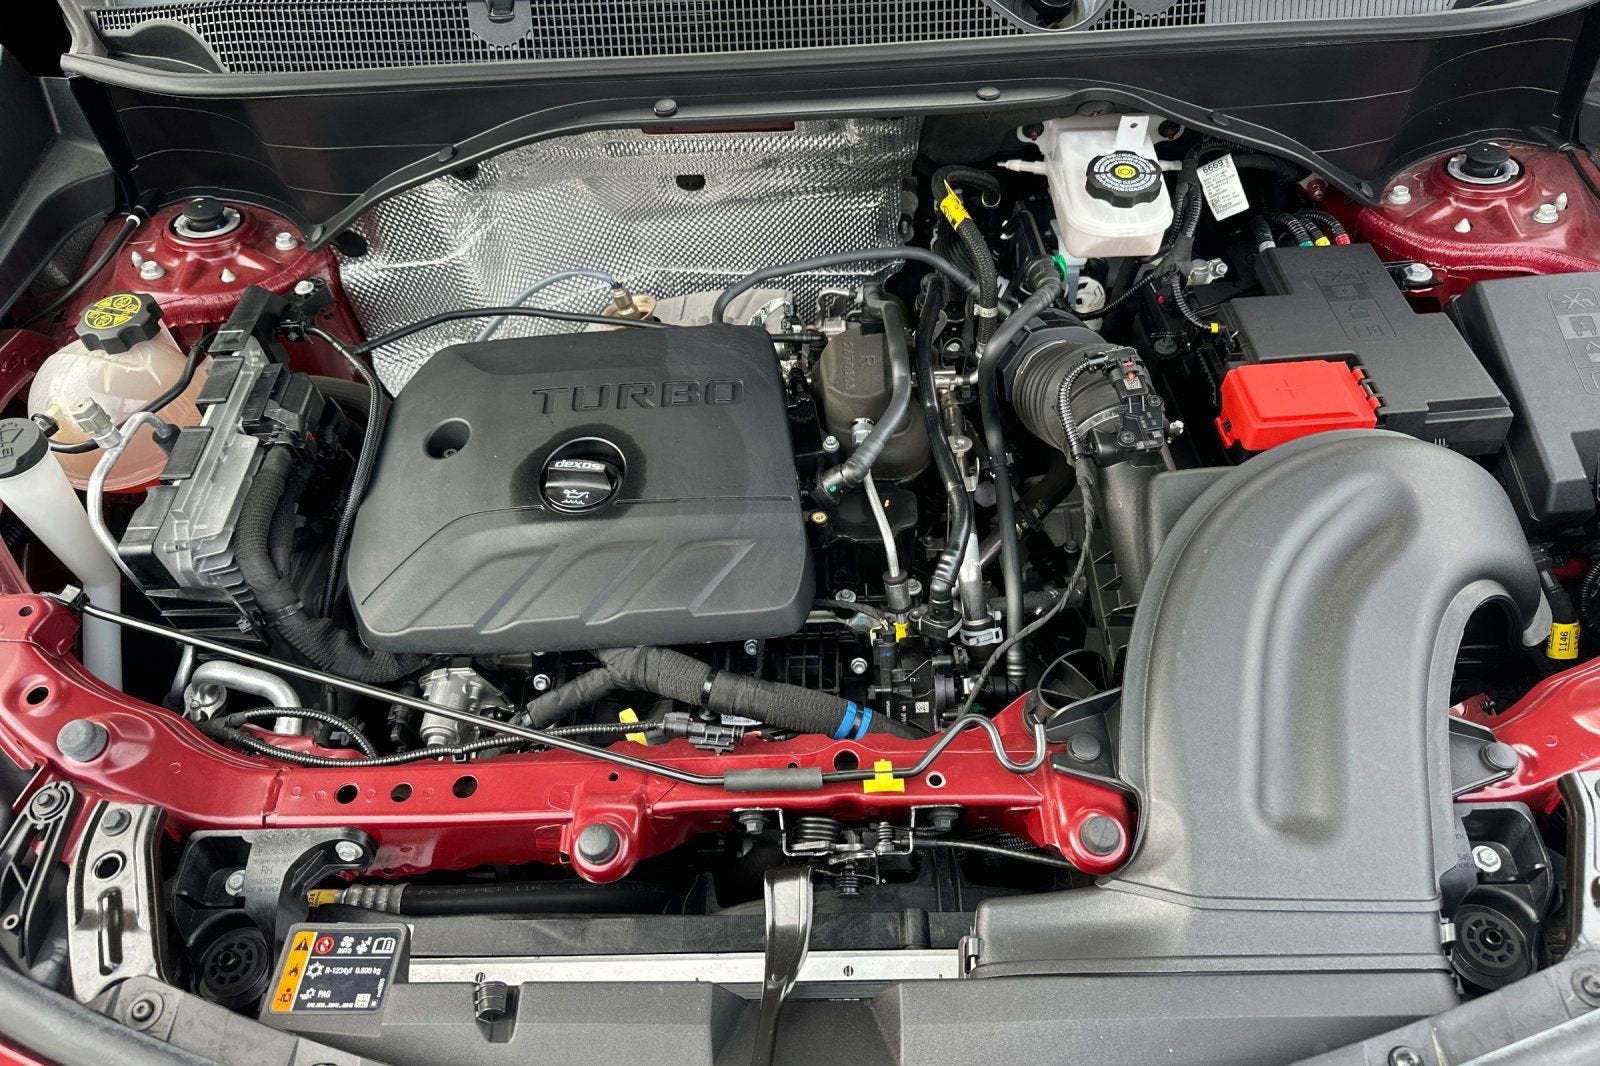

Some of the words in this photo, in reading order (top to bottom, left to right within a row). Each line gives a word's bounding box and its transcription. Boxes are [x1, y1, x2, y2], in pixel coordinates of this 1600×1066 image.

[1202, 159, 1223, 173] 6669
[532, 378, 744, 414] TURBO
[555, 459, 602, 470] dexos
[1558, 631, 1568, 652] 1146
[325, 966, 353, 975] R-1234yf
[373, 966, 381, 975] kg
[317, 990, 332, 998] PAG
